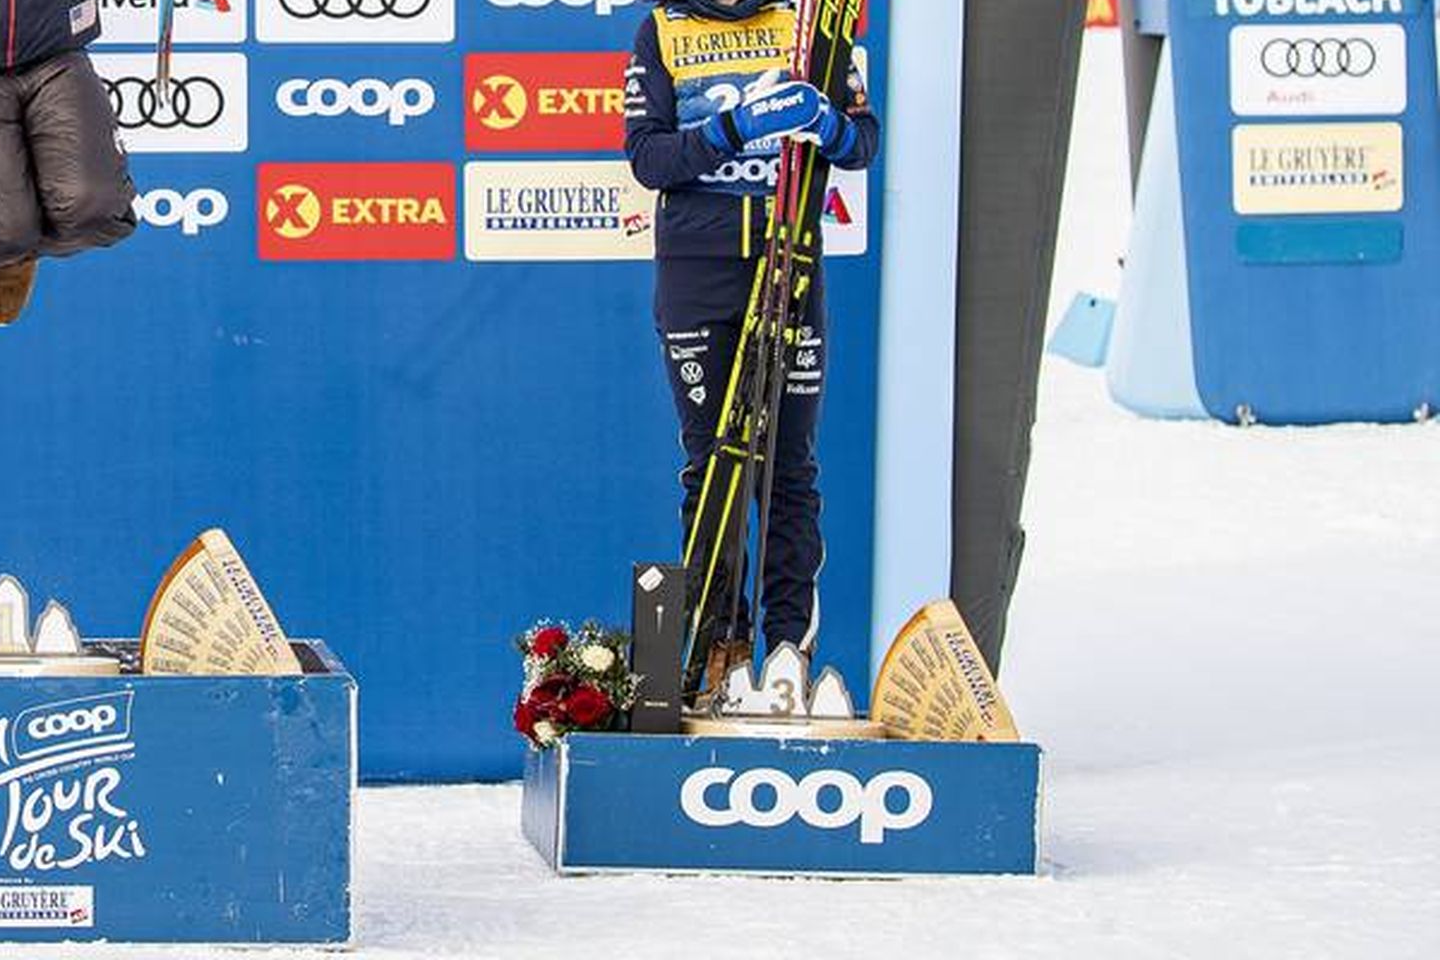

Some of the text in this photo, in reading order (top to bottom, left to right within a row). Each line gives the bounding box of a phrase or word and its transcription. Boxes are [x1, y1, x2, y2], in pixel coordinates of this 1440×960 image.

[274, 78, 436, 126] coop
[537, 88, 625, 116] EXTR
[1249, 149, 1273, 172] LE
[331, 197, 446, 224] EXTRA
[485, 181, 621, 215] LE GRUYÈRE
[769, 678, 796, 716] 3
[27, 704, 117, 739] coop
[679, 766, 934, 844] coop
[9, 833, 57, 871] de
